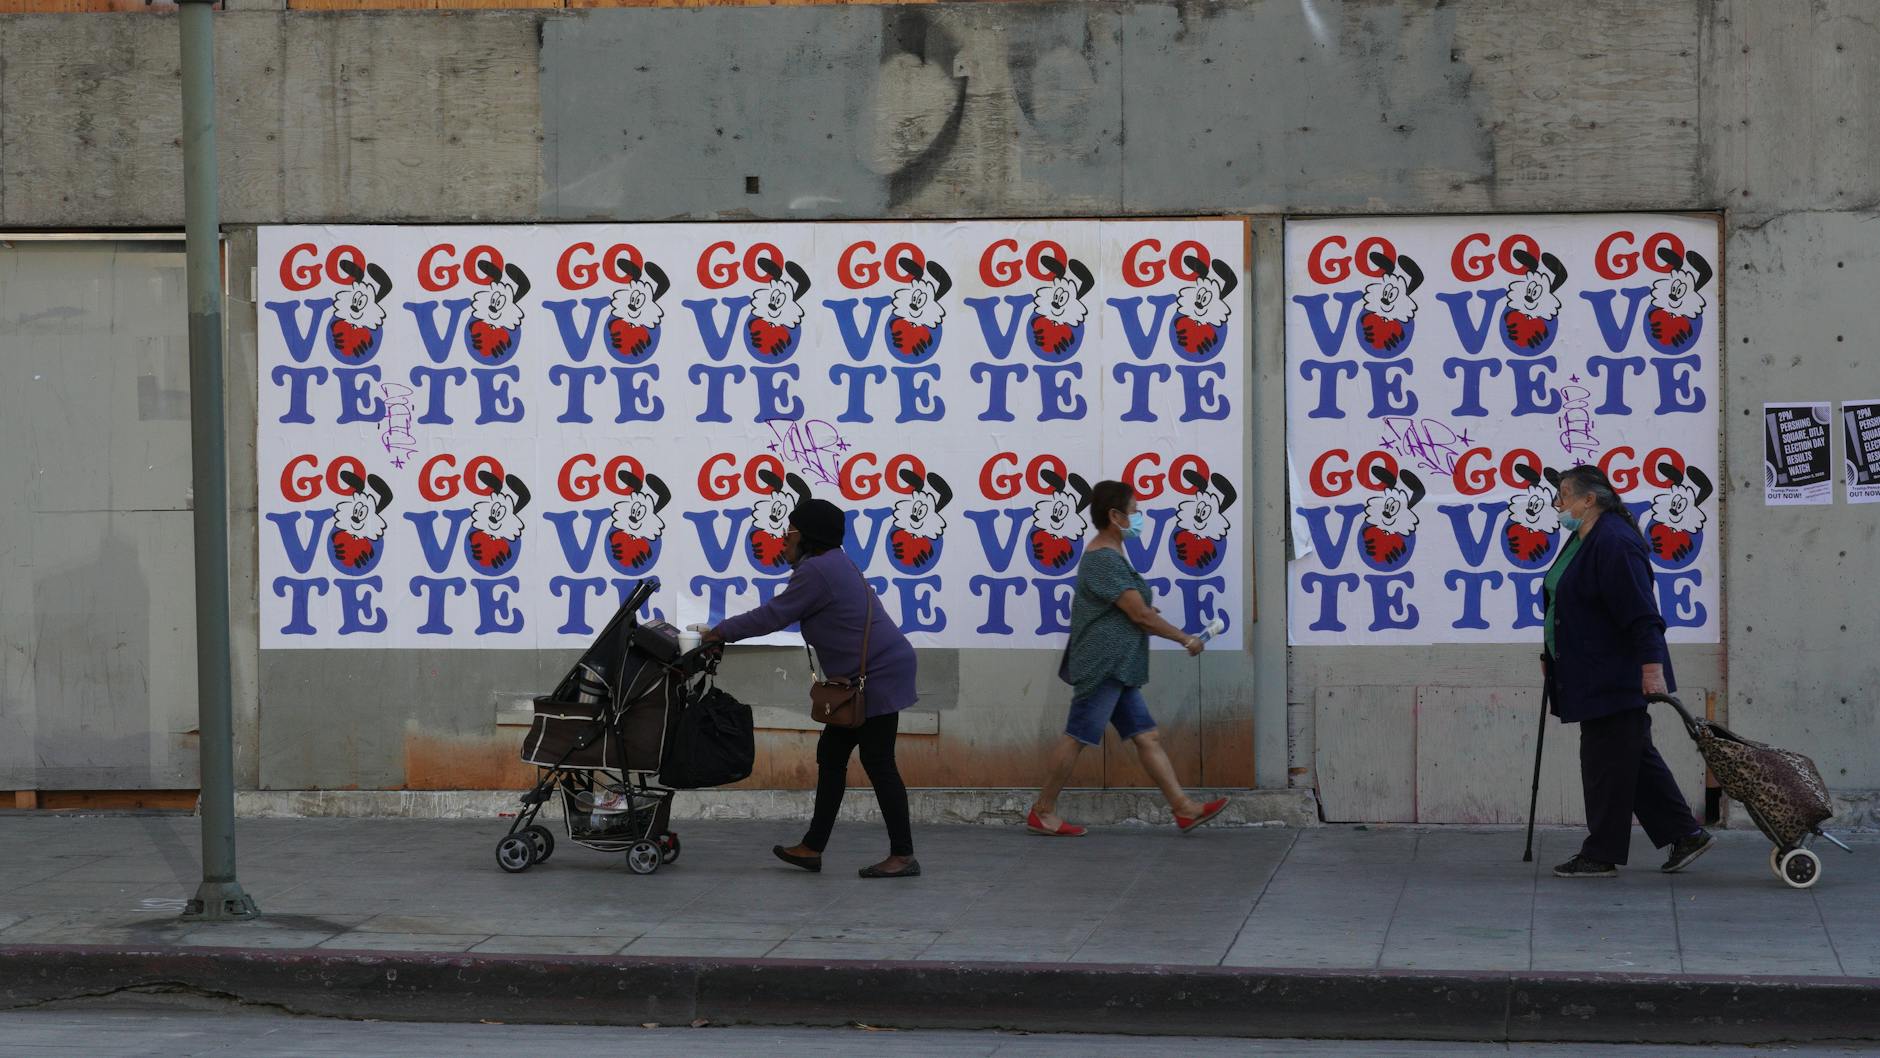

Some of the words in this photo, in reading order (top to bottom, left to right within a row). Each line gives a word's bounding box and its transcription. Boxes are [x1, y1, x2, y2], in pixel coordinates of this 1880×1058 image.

[279, 243, 367, 292] GO
[417, 243, 505, 292] GO
[556, 241, 644, 291] GO
[696, 240, 785, 289] GO
[837, 240, 926, 290] GO
[979, 239, 1068, 288] GO
[1121, 239, 1211, 288] GO
[1307, 235, 1397, 285] GO
[1451, 233, 1541, 282] GO
[1595, 230, 1685, 281] GO
[271, 364, 386, 425] TE
[410, 364, 526, 425] TE
[548, 364, 666, 425] TE
[688, 363, 805, 425] TE
[828, 363, 946, 425] TE
[970, 361, 1089, 423] TE
[1112, 361, 1232, 424] TE
[1299, 357, 1420, 420] TE
[1442, 355, 1564, 418] TE
[1585, 354, 1707, 417] TE
[1778, 410, 1793, 422] 2PM
[1780, 417, 1811, 433] PERSHING
[1782, 429, 1809, 444] SQUARE,
[1809, 426, 1825, 438] DTLA
[1857, 407, 1872, 419] 2PM
[1597, 446, 1685, 495] GO
[1784, 439, 1813, 455] ELECTION
[1812, 437, 1825, 449] DAY
[1786, 450, 1813, 465] RESULTS
[1788, 463, 1811, 476] WATCH
[280, 454, 367, 503] GO
[418, 453, 505, 503] GO
[557, 453, 645, 502] GO
[697, 452, 785, 502] GO
[838, 452, 926, 501] GO
[978, 452, 1067, 501] GO
[1121, 452, 1210, 501] GO
[1309, 448, 1399, 497] GO
[1452, 447, 1543, 496] GO
[1624, 499, 1705, 571] O
[272, 575, 389, 637] TE
[409, 575, 525, 637] TE
[866, 574, 948, 636] E
[1145, 575, 1231, 636] E
[1300, 570, 1420, 633] TE
